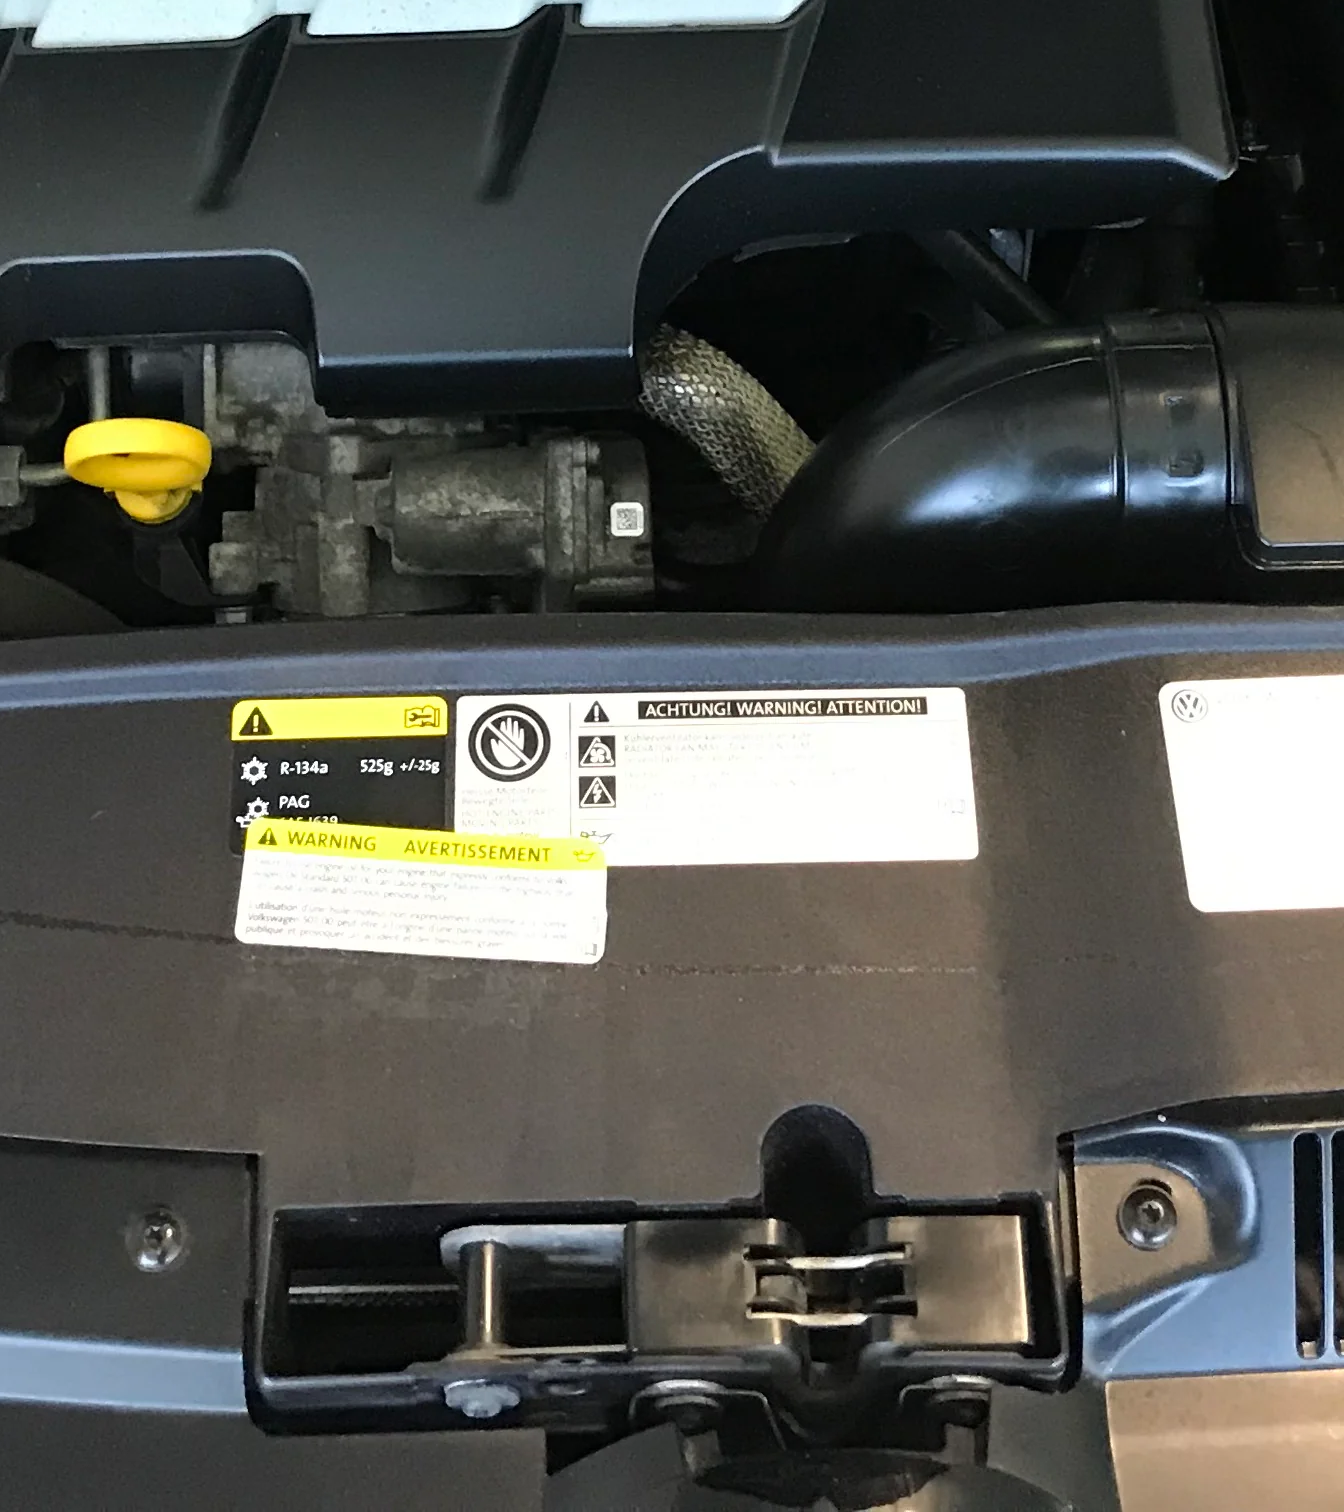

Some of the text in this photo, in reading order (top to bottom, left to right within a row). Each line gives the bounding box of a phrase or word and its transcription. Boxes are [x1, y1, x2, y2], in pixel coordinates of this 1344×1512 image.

[645, 698, 922, 717] ACHTUNG! WARNING! ATTENTION!
[280, 757, 441, 776] R-134a 525g +/-25g
[279, 794, 310, 809] PAG
[288, 830, 552, 863] WARNING AVERTISSEMENT
